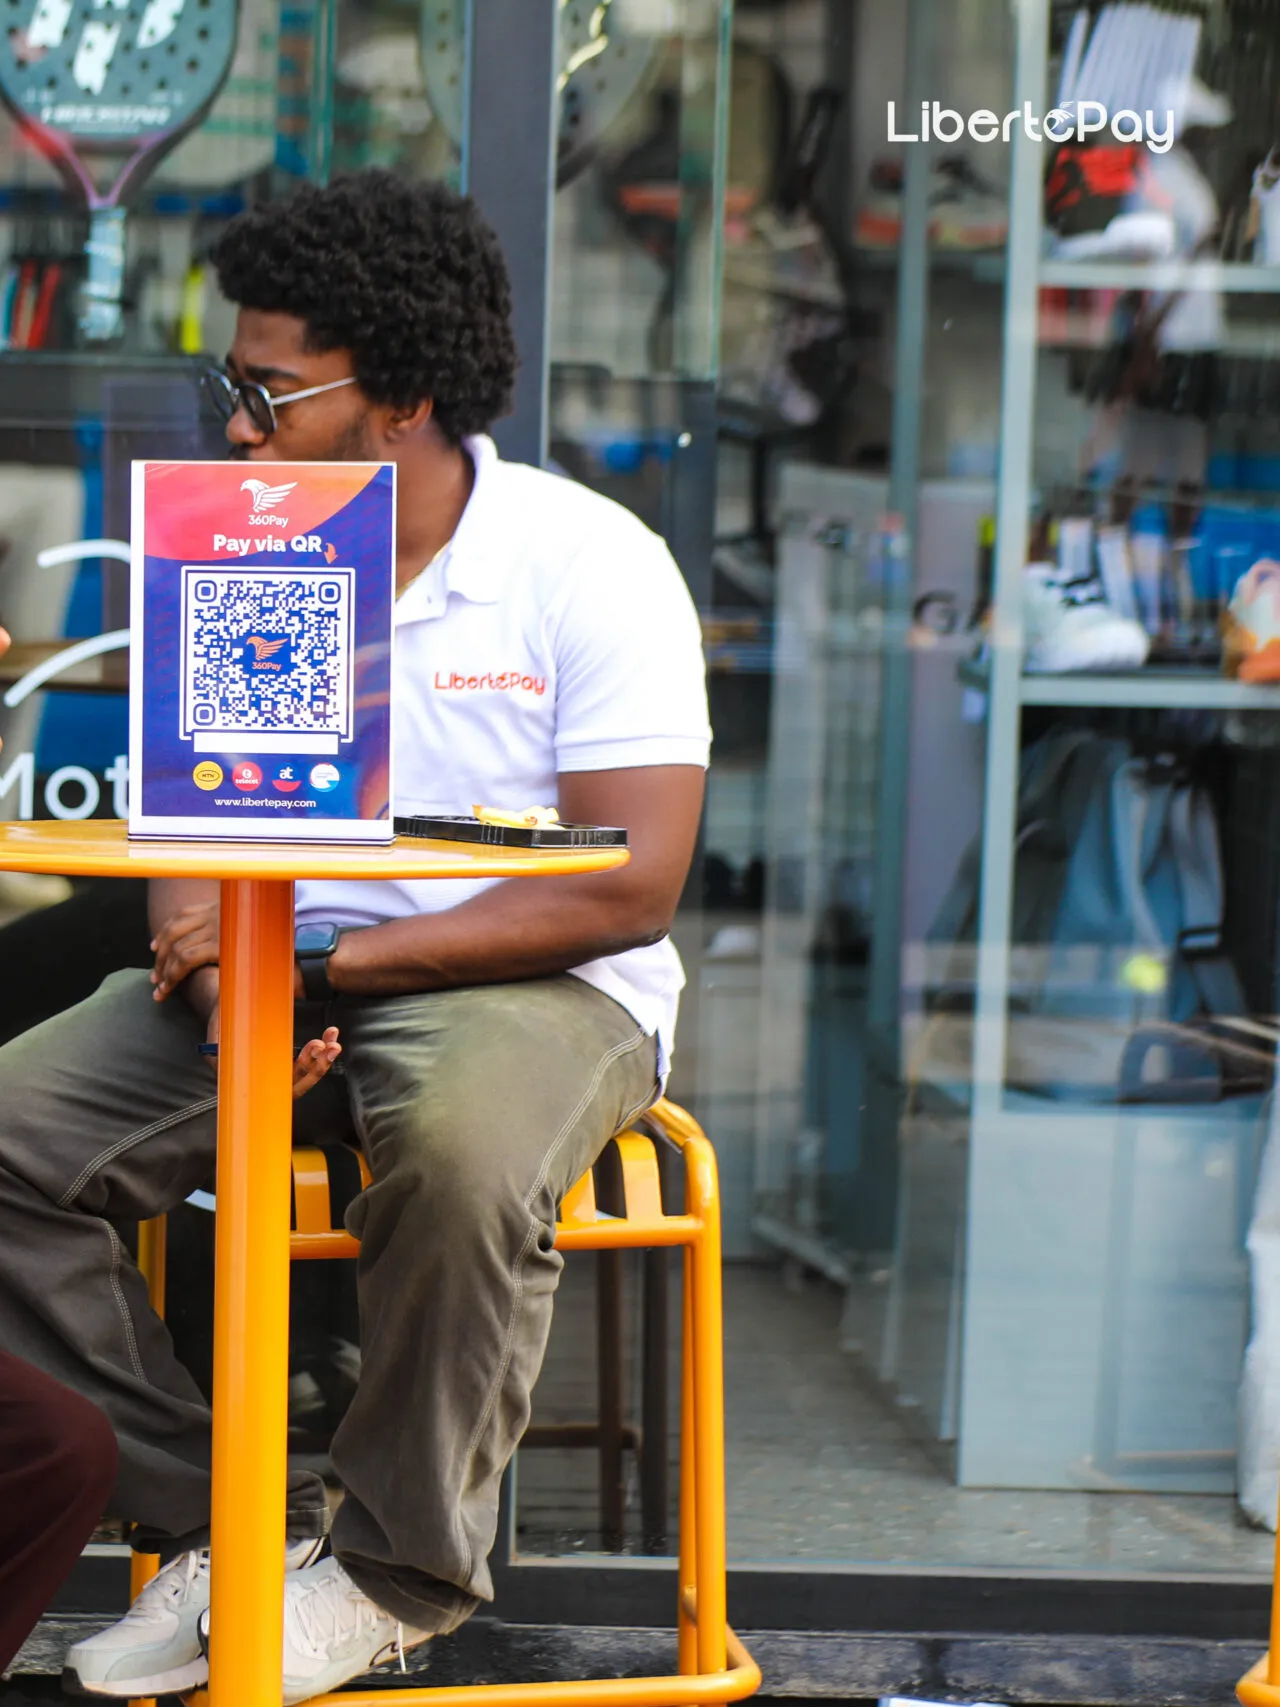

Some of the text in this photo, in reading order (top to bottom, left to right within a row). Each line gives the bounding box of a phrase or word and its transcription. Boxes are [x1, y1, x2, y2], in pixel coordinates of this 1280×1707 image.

[248, 514, 289, 528] 360Pay
[213, 533, 322, 557] Pay via QR
[252, 661, 282, 672] 360Pay
[279, 766, 294, 780] at
[214, 797, 317, 809] www.libertepay.com
